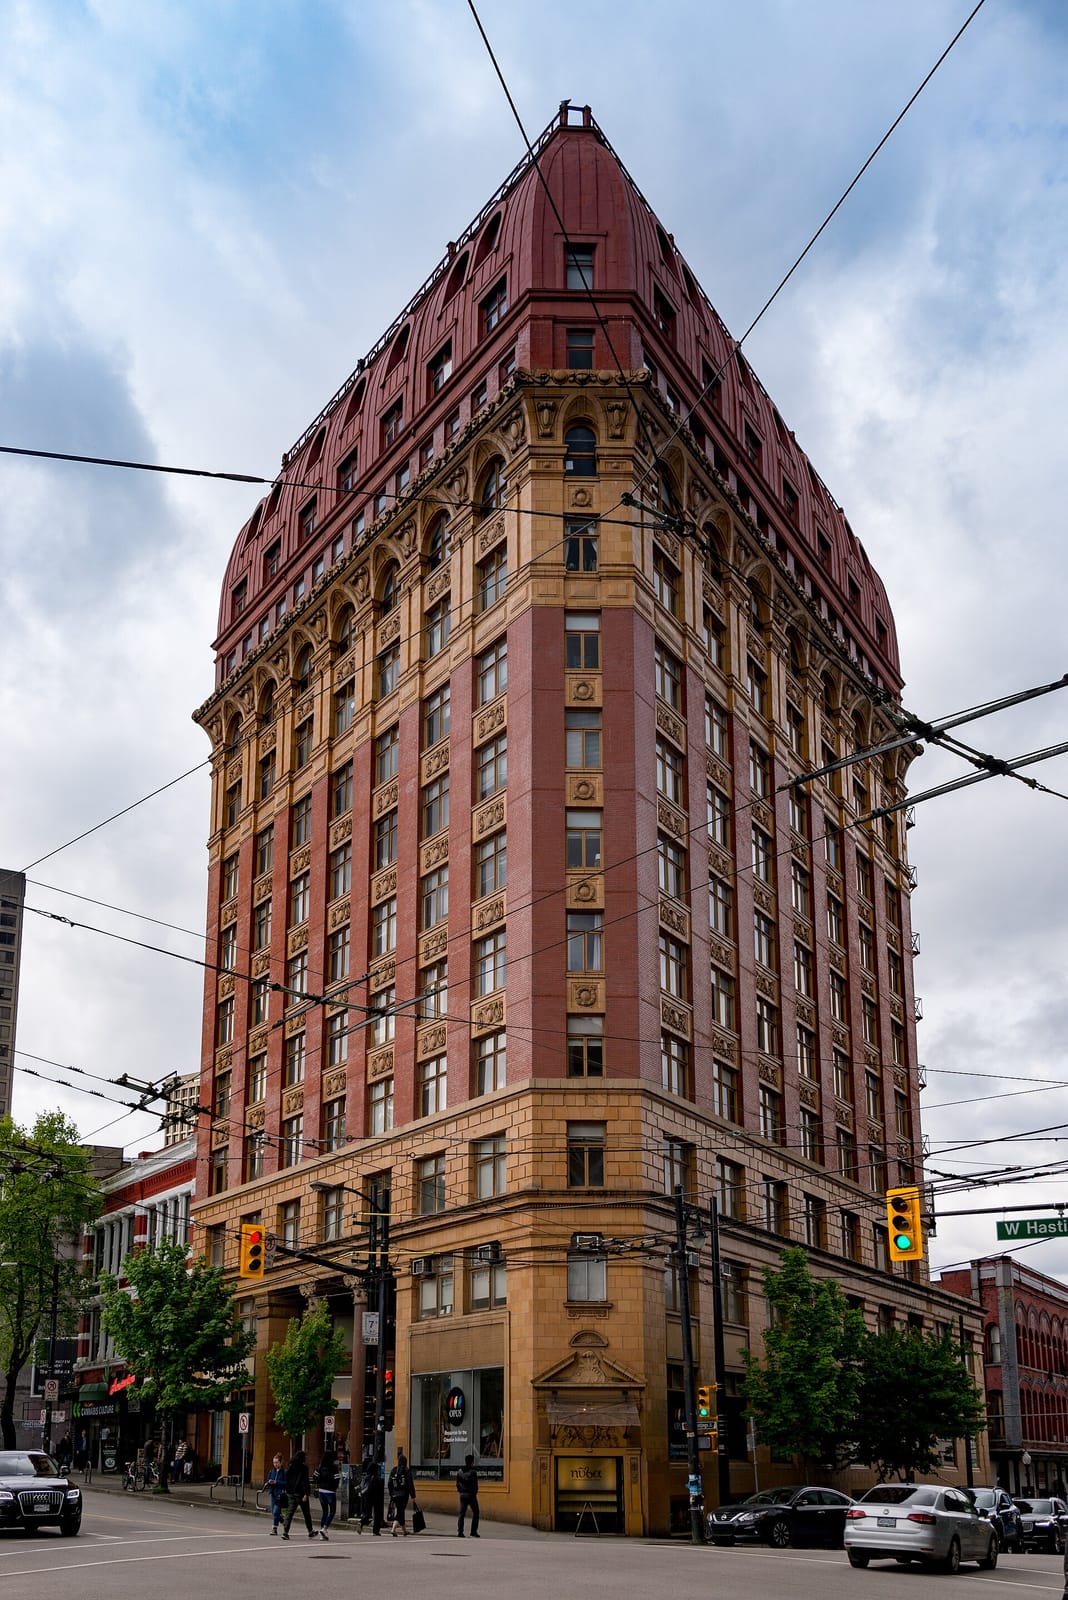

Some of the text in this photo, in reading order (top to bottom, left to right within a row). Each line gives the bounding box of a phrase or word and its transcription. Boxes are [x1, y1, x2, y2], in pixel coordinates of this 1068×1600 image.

[1004, 1220, 1068, 1235] W Hasti
[81, 1406, 98, 1417] CANNABIS
[99, 1404, 114, 1415] CULTURE
[448, 1409, 462, 1418] OPUS
